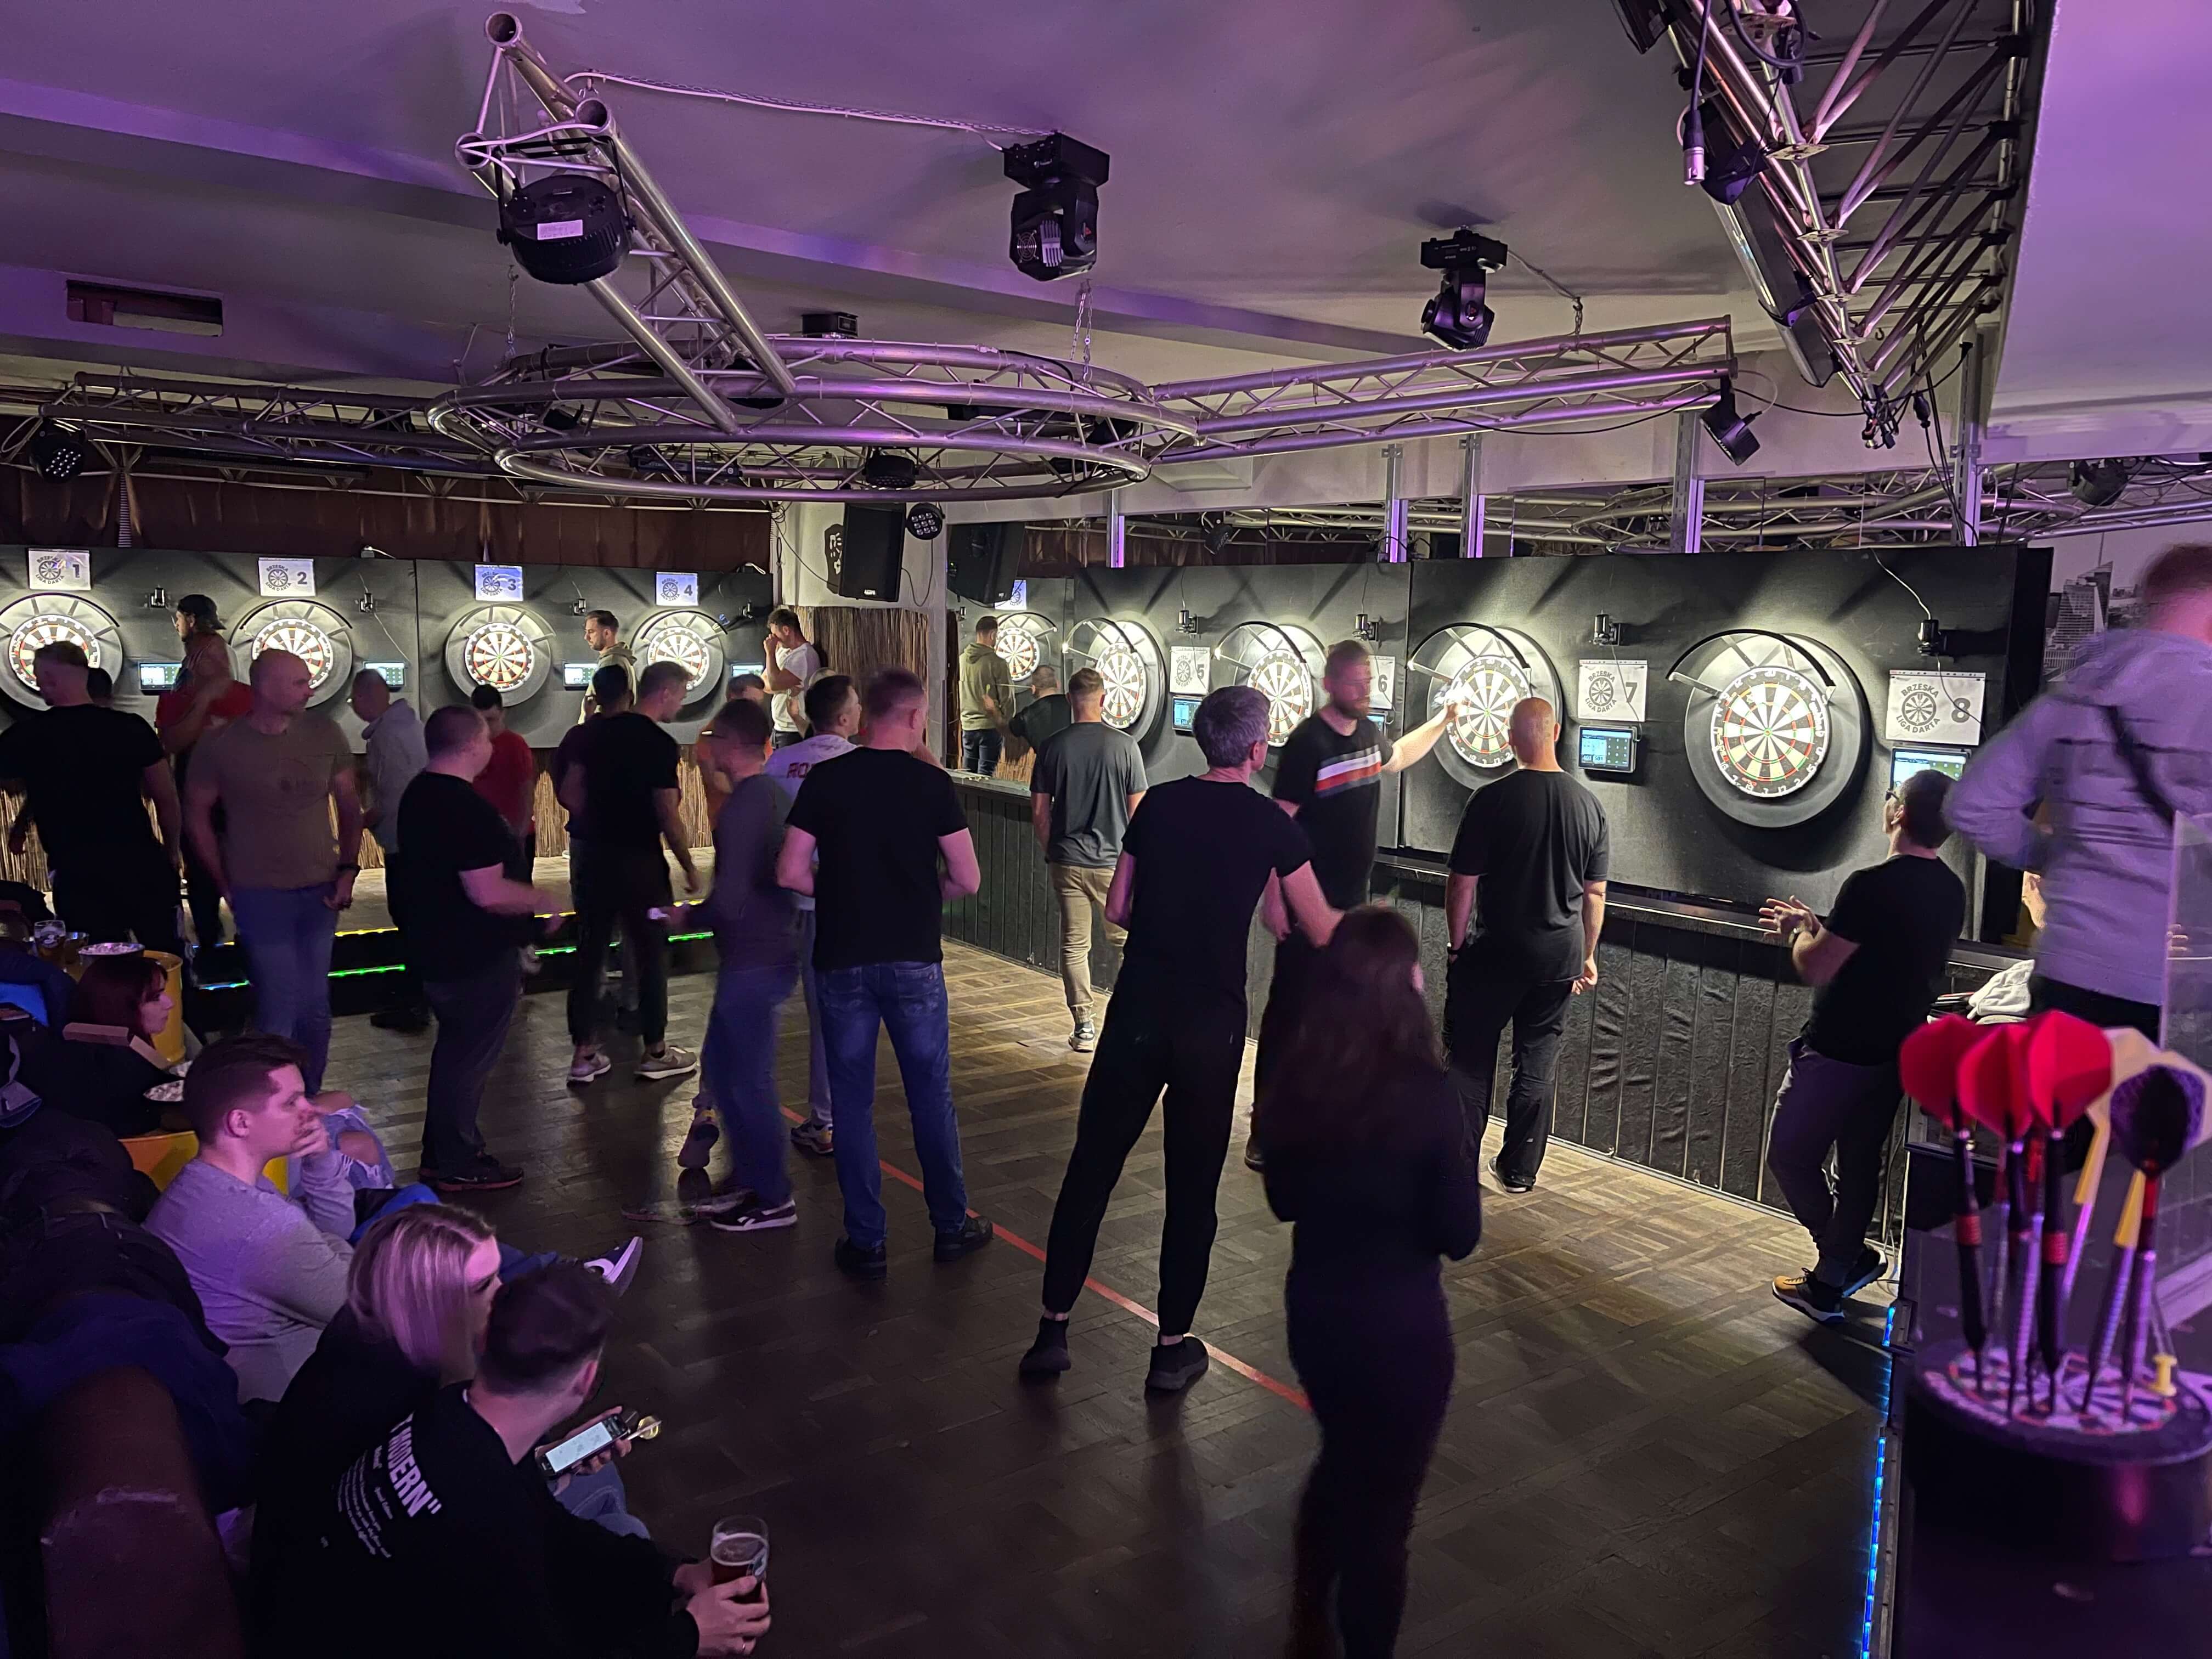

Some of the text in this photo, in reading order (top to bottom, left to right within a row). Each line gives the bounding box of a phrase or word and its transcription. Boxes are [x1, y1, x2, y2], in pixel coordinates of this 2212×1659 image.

[72, 564, 80, 578] 1
[297, 572, 307, 584] 2
[508, 578, 516, 591] 3
[684, 584, 693, 596] 4
[1197, 664, 1205, 680] 5
[1588, 670, 1616, 683] BRZESKA
[1378, 674, 1388, 692] 6
[1626, 682, 1638, 703] 7
[1900, 684, 1939, 698] BRZESKA
[1585, 698, 1617, 713] LIGA DARTA
[1951, 697, 1971, 723] 8
[1896, 715, 1940, 733] LIGA DARTA
[786, 762, 813, 778] RO
